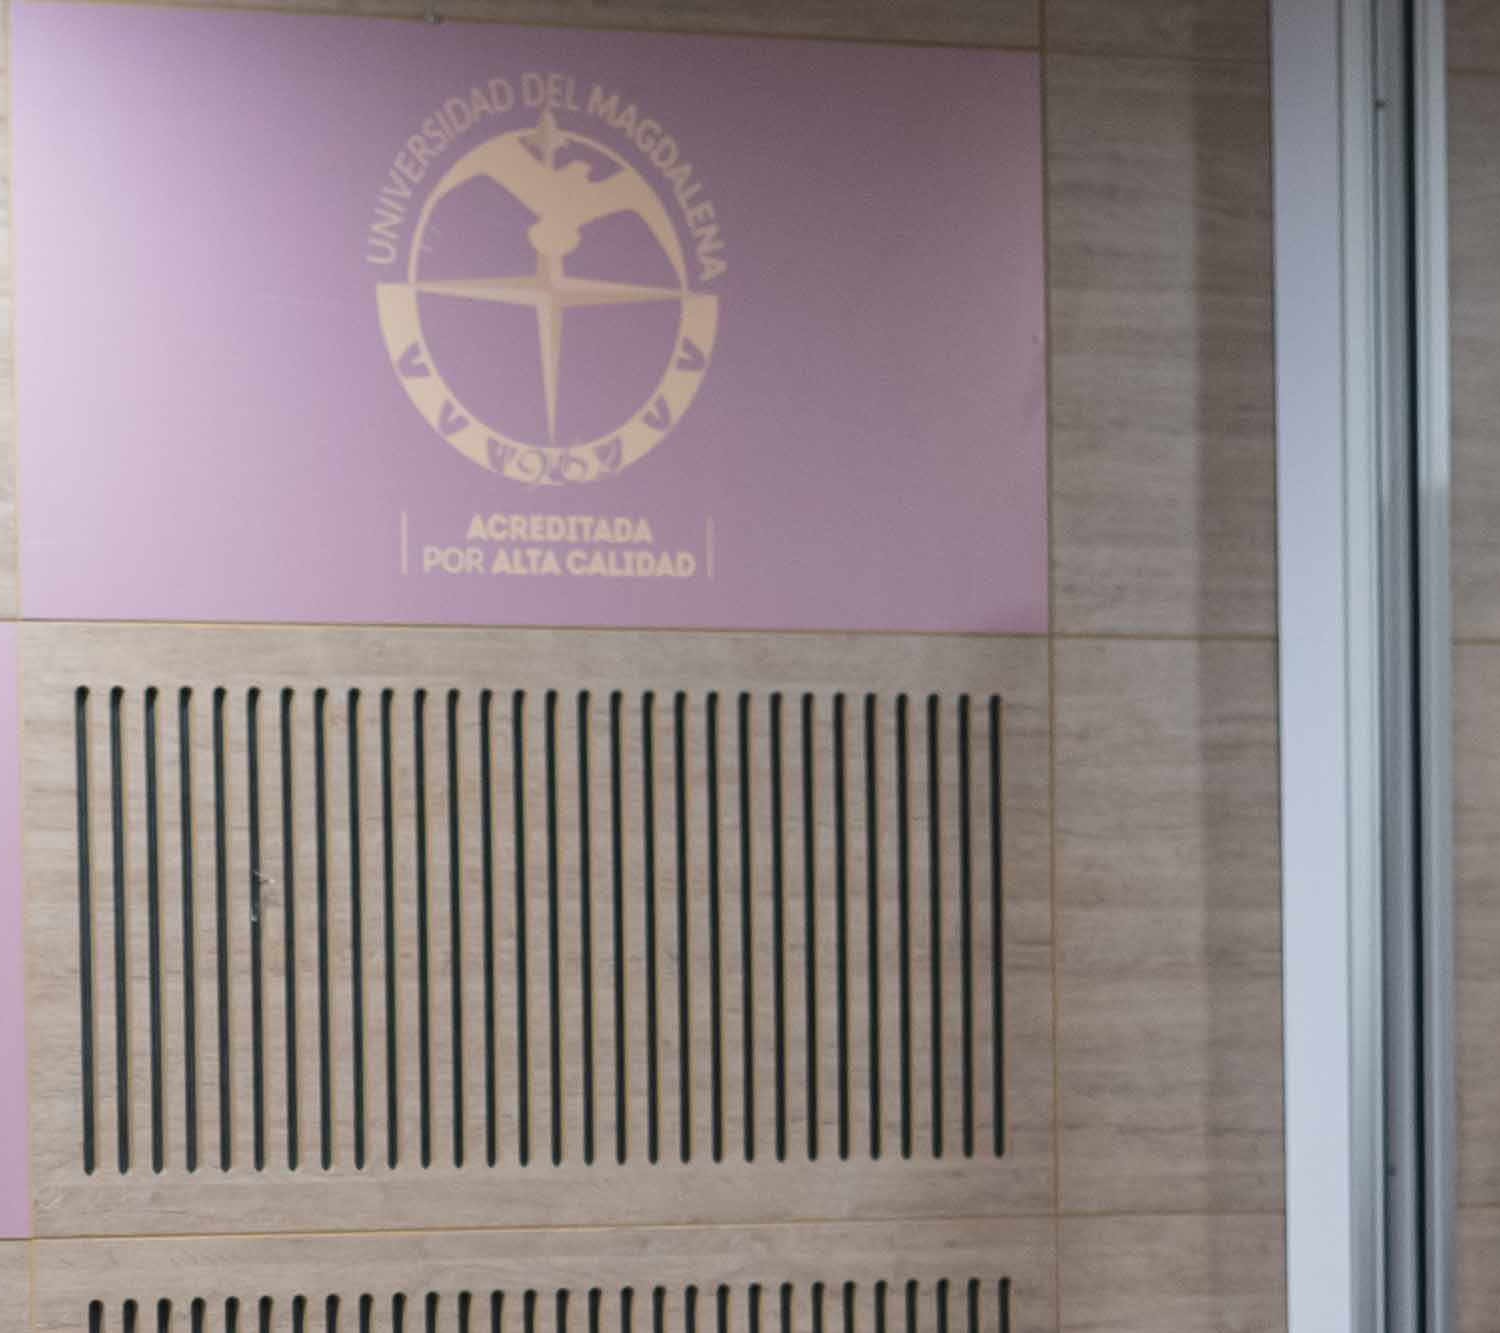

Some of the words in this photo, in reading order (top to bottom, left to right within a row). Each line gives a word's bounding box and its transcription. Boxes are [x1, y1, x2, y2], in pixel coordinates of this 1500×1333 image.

[365, 77, 515, 265] UNIVERSIDAD
[520, 72, 581, 111] DEL
[587, 83, 729, 282] MAGDALENA
[466, 513, 654, 543] ACREDITADA
[423, 544, 485, 574] POR
[491, 547, 562, 576] ALTA
[567, 550, 697, 577] CALIDAD
